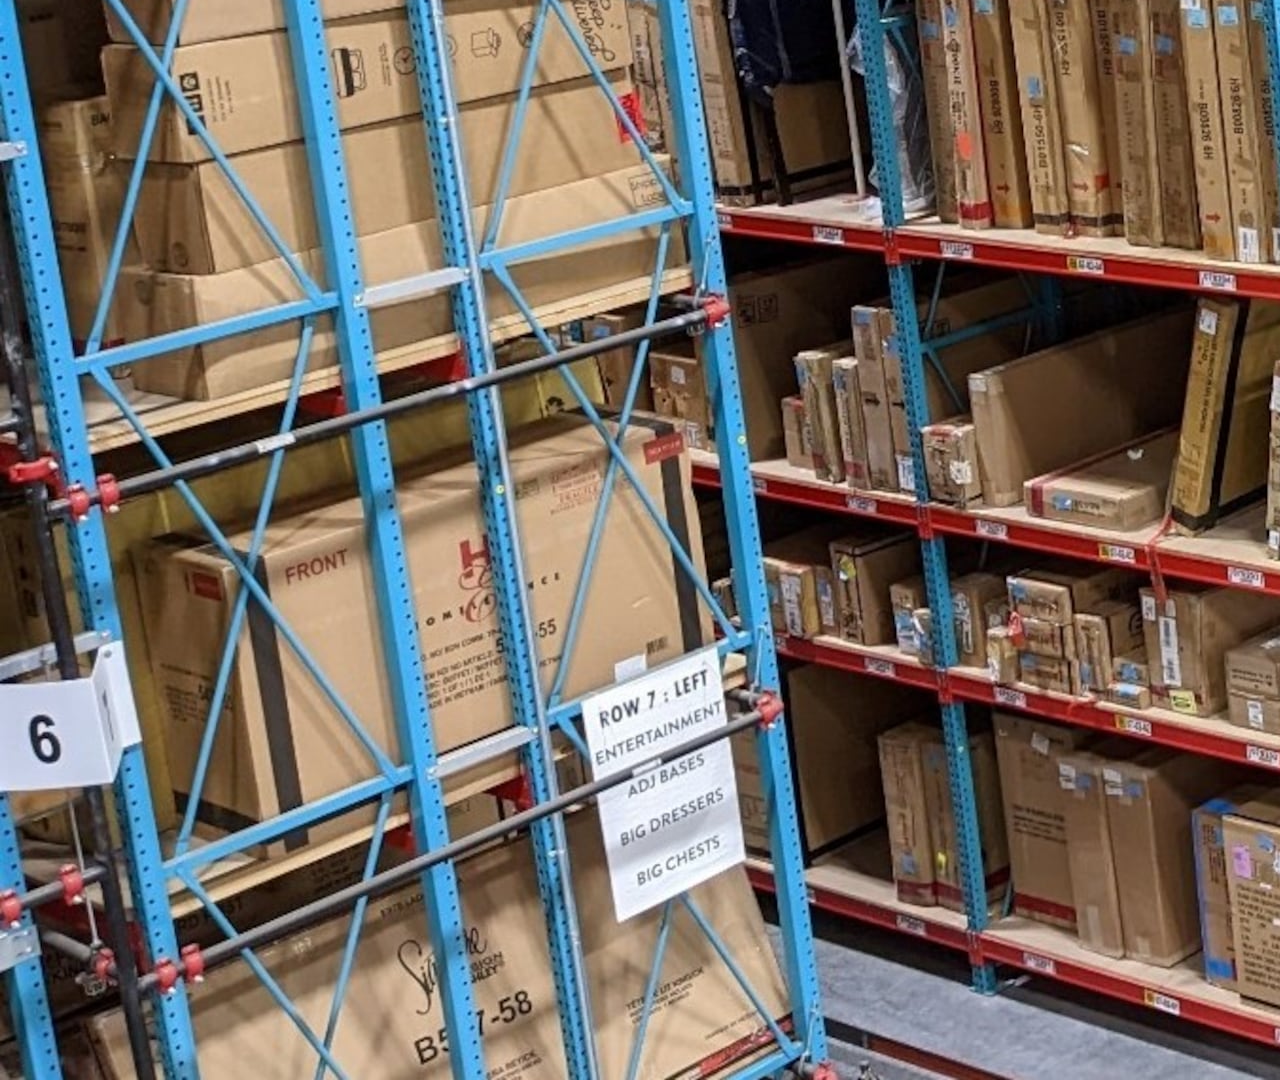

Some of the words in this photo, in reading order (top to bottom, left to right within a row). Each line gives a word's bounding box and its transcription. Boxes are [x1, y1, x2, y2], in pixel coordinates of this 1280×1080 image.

[284, 549, 348, 585] FRONT
[599, 700, 639, 729] ROW
[647, 691, 657, 710] 7
[675, 670, 708, 697] LEFT
[29, 714, 61, 764] 6
[595, 701, 722, 765] ENTERTAINMENT
[627, 776, 657, 798] ADJ
[660, 753, 705, 785] BASES
[620, 823, 646, 847] BIG
[650, 787, 724, 833] DRESSERS
[636, 862, 663, 886] BIG
[666, 835, 721, 871] CHESTS
